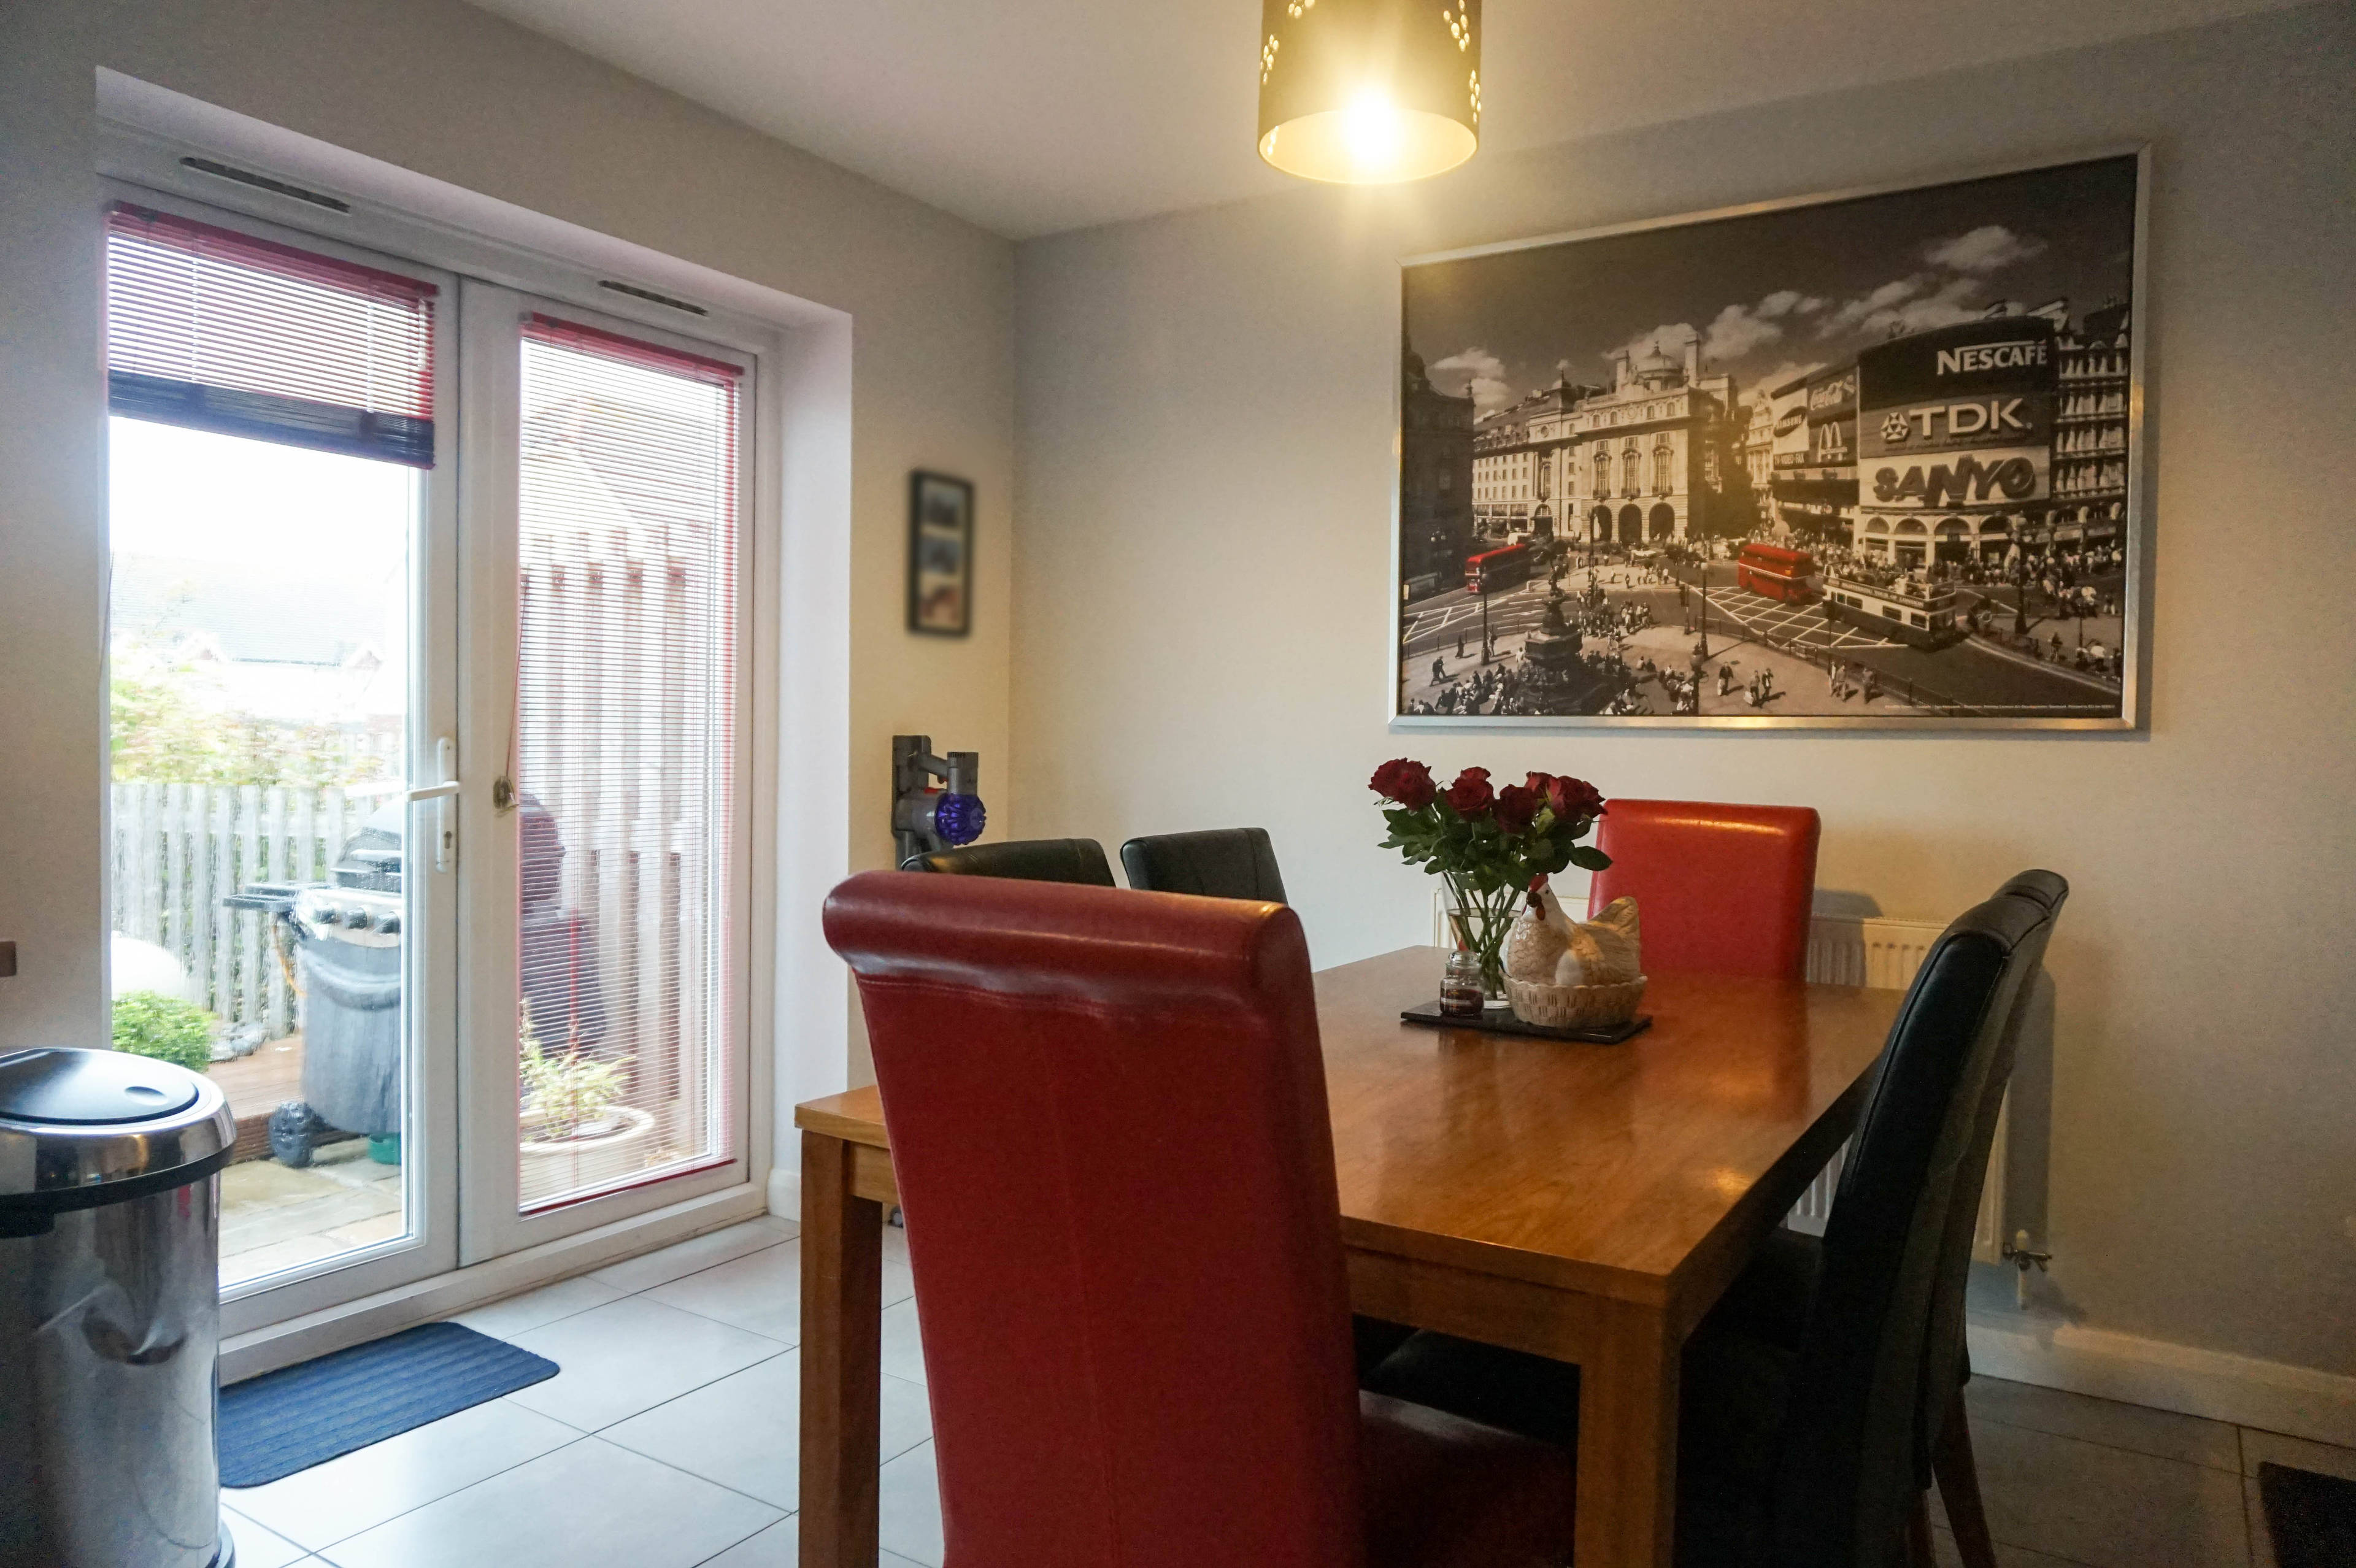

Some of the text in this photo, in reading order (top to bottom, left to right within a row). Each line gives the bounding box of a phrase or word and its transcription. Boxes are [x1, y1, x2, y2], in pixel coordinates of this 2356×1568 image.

[1937, 339, 2047, 376] NESCAFÉ
[1909, 398, 2023, 437] TDK
[1873, 454, 2036, 509] SANYO
